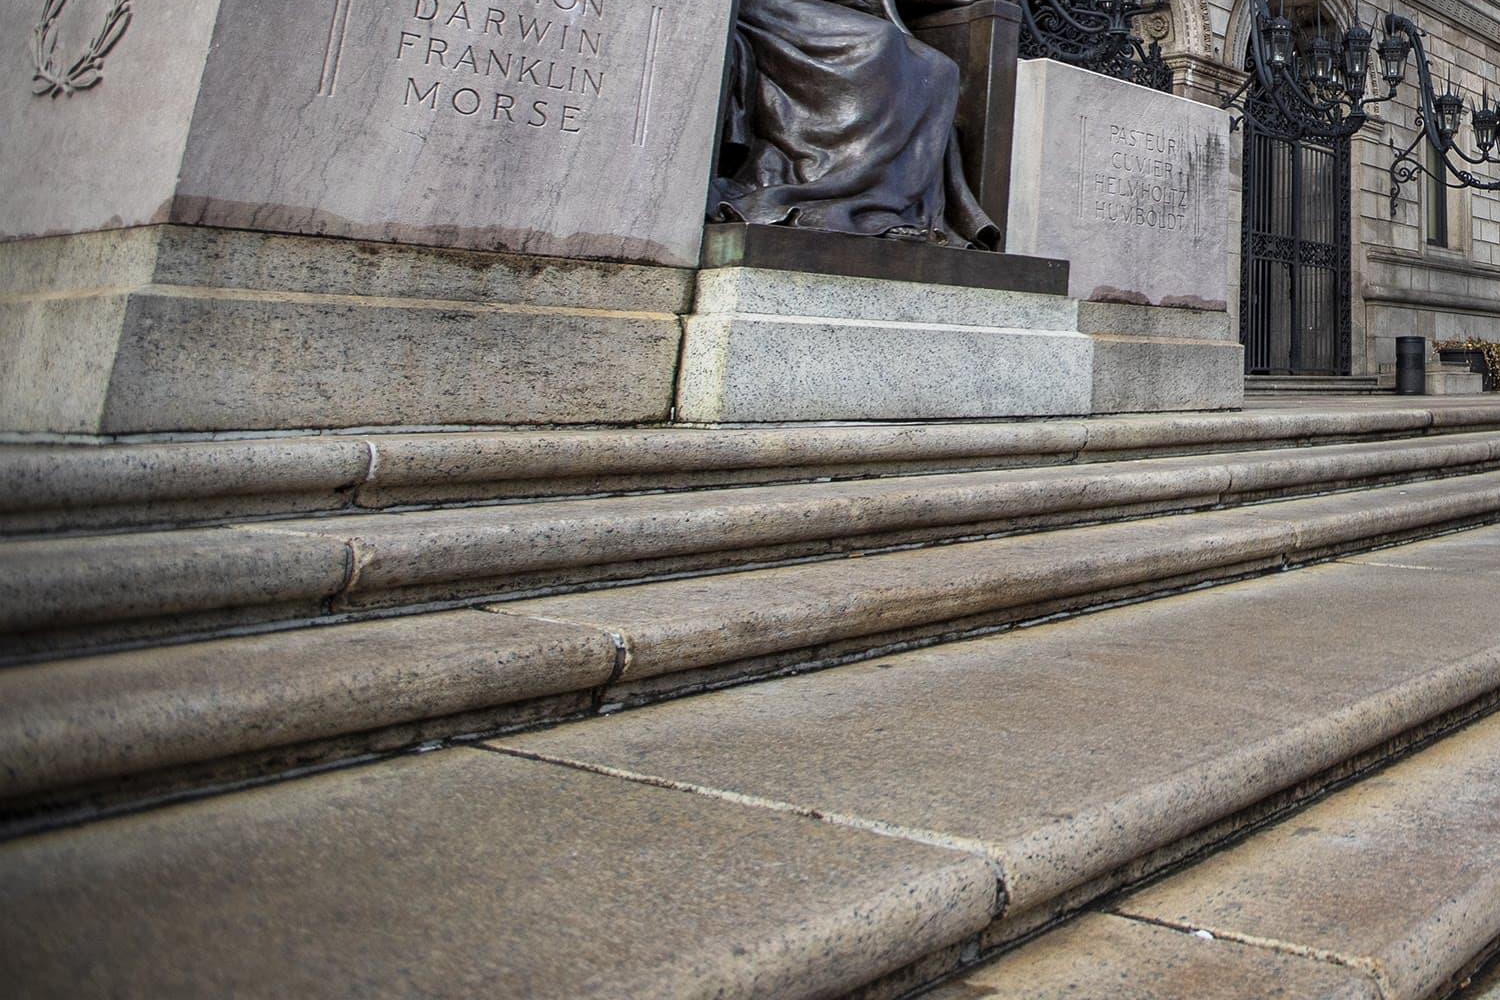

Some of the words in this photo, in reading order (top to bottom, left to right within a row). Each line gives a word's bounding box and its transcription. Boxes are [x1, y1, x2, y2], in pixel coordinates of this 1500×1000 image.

[396, 31, 605, 99] FRANKLIN
[403, 76, 582, 133] MORSE
[1110, 124, 1177, 157] PASTEUR
[1112, 151, 1174, 180] CUVIER
[1095, 173, 1187, 209] HELMHOLTZ
[1095, 200, 1185, 231] HUMBOLDT
